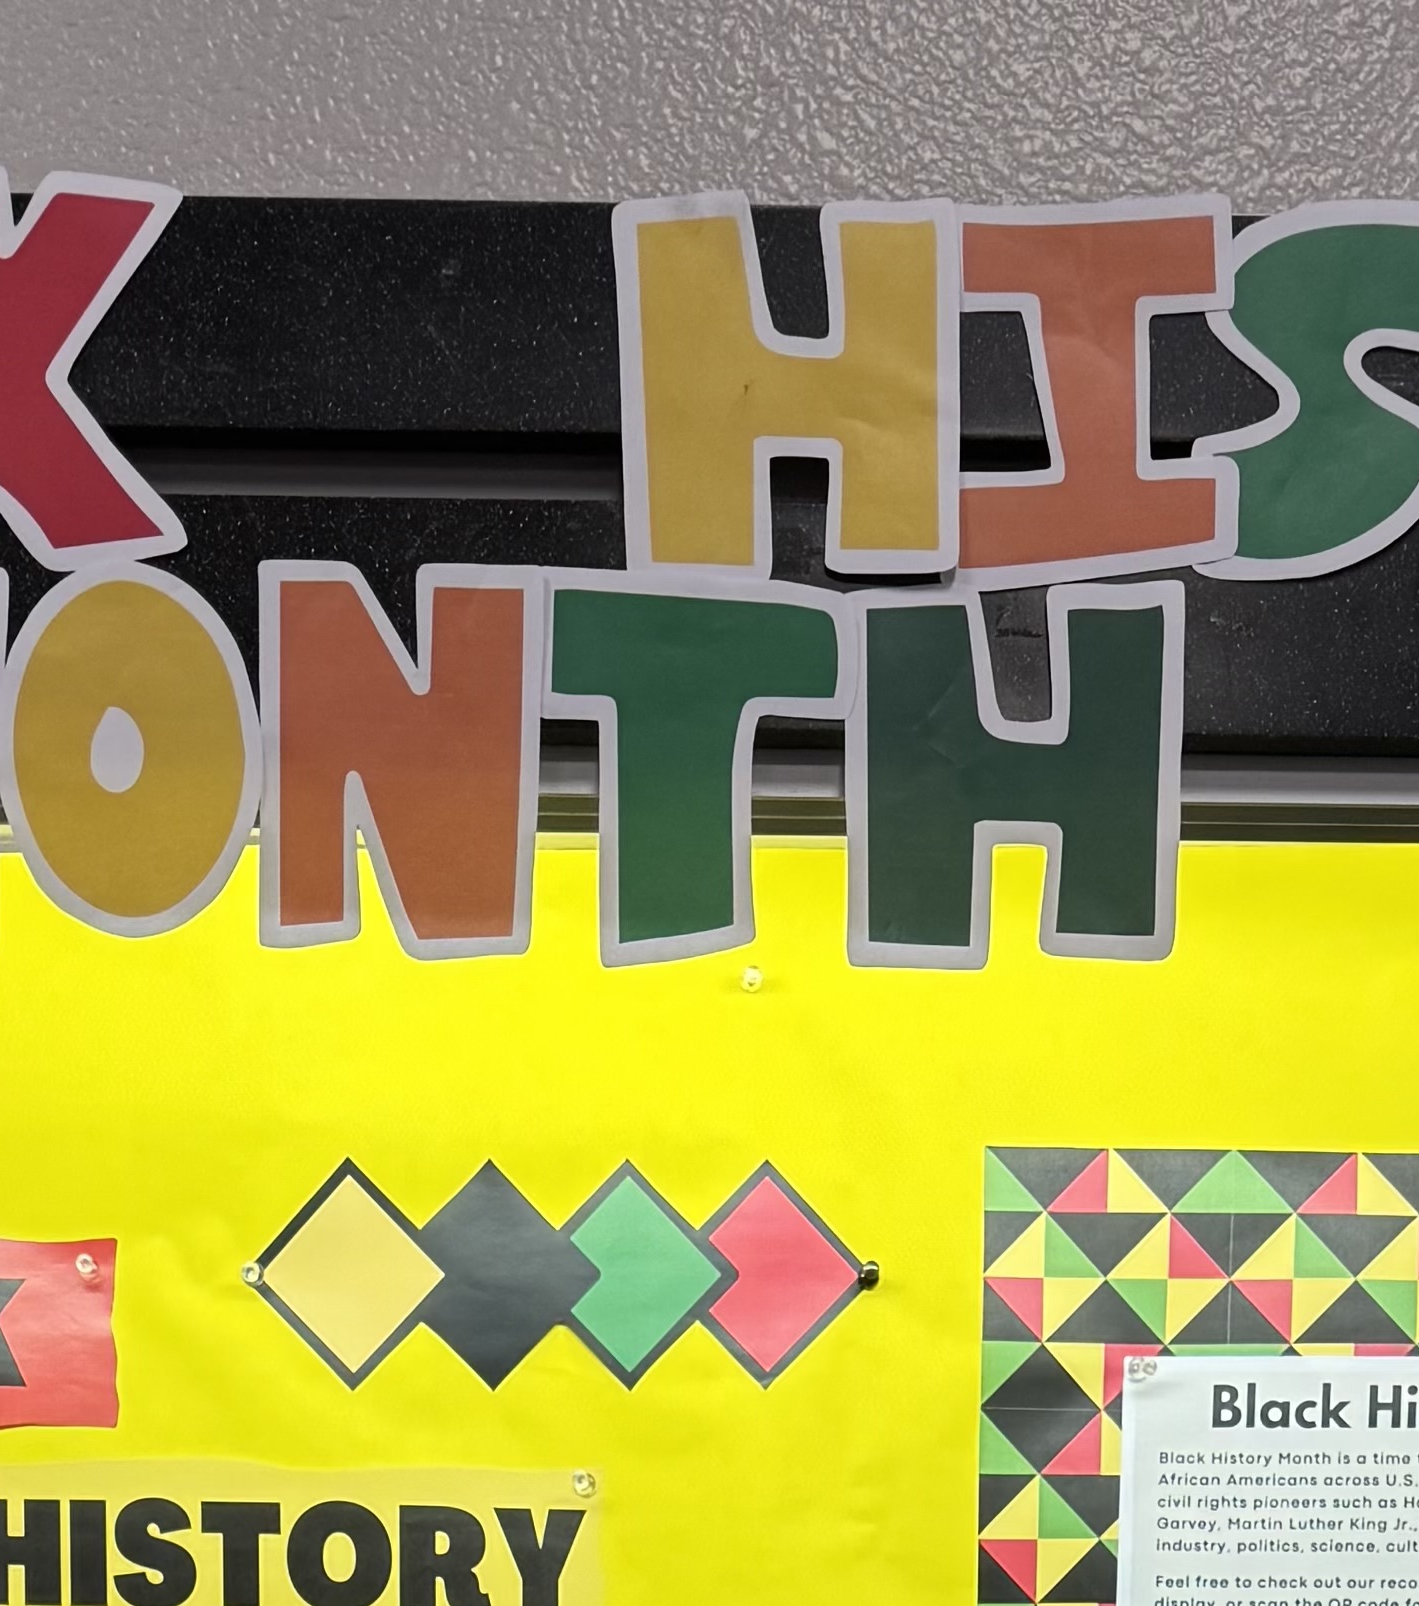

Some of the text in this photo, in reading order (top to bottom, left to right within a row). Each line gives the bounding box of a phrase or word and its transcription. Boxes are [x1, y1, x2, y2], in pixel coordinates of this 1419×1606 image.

[1212, 1383, 1351, 1429] Black
[1160, 1452, 1205, 1464] Black
[1212, 1452, 1272, 1467] History
[1278, 1452, 1331, 1464] Month
[1338, 1452, 1350, 1464] is
[1356, 1455, 1366, 1464] a
[1373, 1452, 1411, 1465] time
